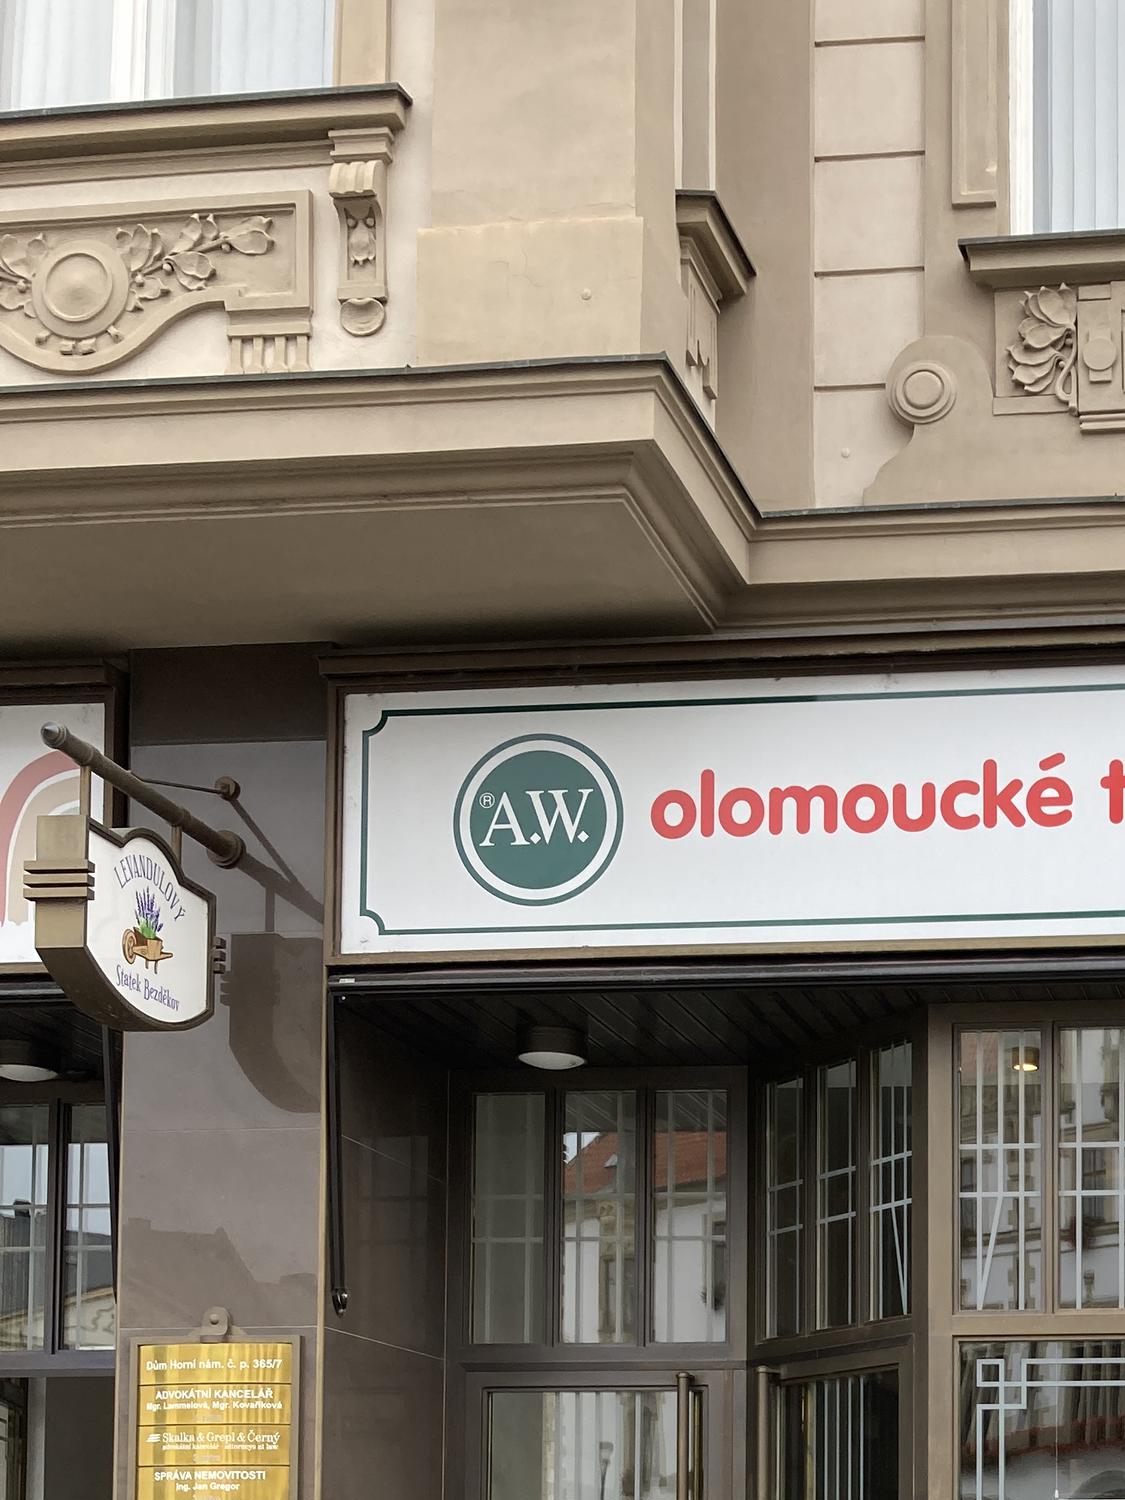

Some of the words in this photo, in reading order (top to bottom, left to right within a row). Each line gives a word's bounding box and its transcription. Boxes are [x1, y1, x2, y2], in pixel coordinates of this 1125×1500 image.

[650, 752, 1074, 840] olomoucké
[114, 854, 187, 922] LEVANDULOVÝ
[115, 964, 142, 993] Statek
[143, 978, 180, 1012] Bezděkov
[146, 1360, 167, 1371] Dům
[170, 1359, 196, 1370] Horní
[199, 1360, 224, 1369] nám.
[240, 1361, 249, 1370] p.
[253, 1359, 282, 1369] 365/7
[156, 1388, 211, 1399] ADVOKÁTNÍ
[215, 1388, 273, 1399] KANCELÁŘ
[213, 1402, 230, 1410] Mgr.
[162, 1432, 194, 1442] Skalka
[206, 1432, 235, 1443] Grepl
[248, 1430, 280, 1444] Černý
[154, 1470, 192, 1481] SPRÁVA
[194, 1470, 266, 1480] NEMOVITOSTI
[176, 1483, 190, 1491] Ing.
[210, 1482, 240, 1491] Gregor
